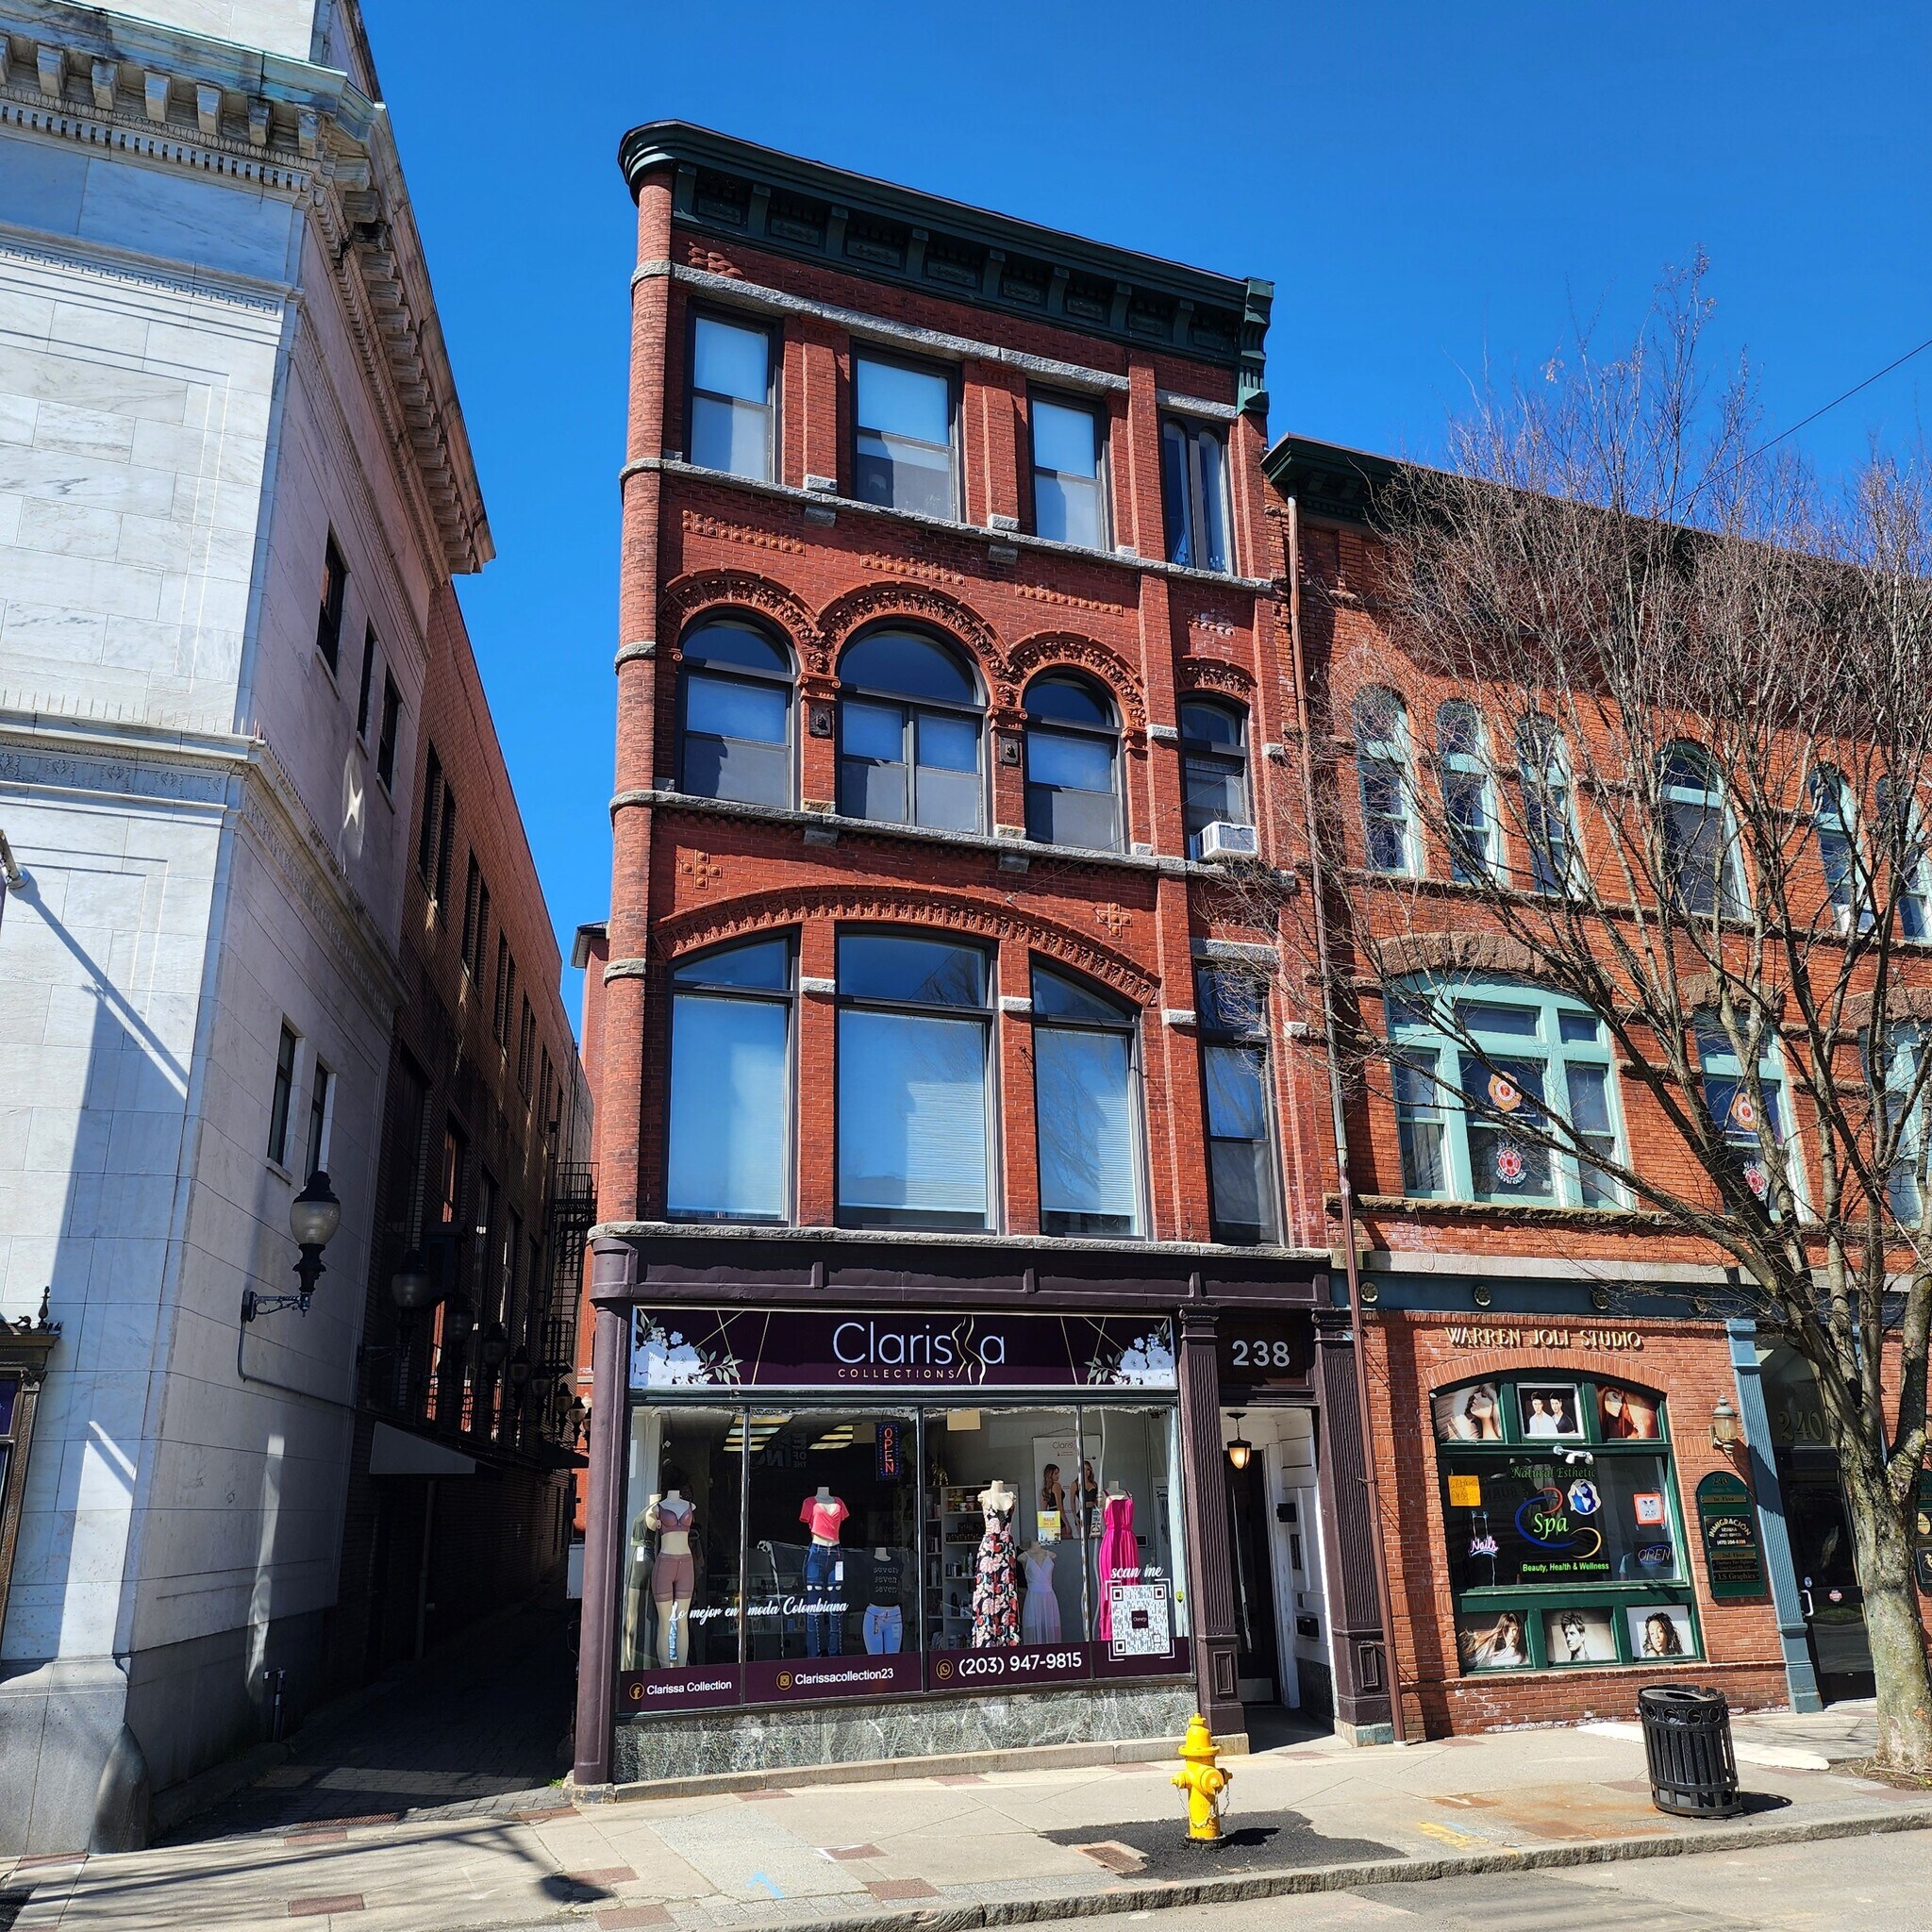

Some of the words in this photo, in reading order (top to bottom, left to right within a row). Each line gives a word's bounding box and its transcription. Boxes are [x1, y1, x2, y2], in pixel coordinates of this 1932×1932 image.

[1444, 1326, 1523, 1346] WARREN
[1529, 1328, 1570, 1346] JOLI
[1579, 1329, 1642, 1348] STUDIO
[1232, 1340, 1291, 1367] 238
[838, 1369, 955, 1379] COLLECTIONS
[1777, 1411, 1824, 1441] 240
[884, 1427, 894, 1473] OPEN
[1510, 1466, 1555, 1480] Natural
[1557, 1466, 1597, 1479] Esthetic
[1533, 1512, 1570, 1540] Spa
[1470, 1536, 1499, 1553] Nails
[1638, 1548, 1671, 1561] OPEN
[1111, 1567, 1141, 1579] scan
[1144, 1564, 1164, 1578] me
[1523, 1563, 1548, 1574] Beauty,
[1549, 1562, 1571, 1572] Health
[1573, 1561, 1578, 1571] &
[1579, 1561, 1609, 1571] Wellness
[669, 1601, 688, 1622] Lo
[690, 1605, 723, 1625] mejor
[724, 1606, 739, 1617] en
[747, 1601, 780, 1616] moda
[782, 1596, 848, 1616] Colombiana
[958, 1656, 1005, 1675] (203)
[1009, 1651, 1083, 1671] 947-9815
[794, 1667, 894, 1685] Clarissacollection23
[646, 1683, 685, 1696] Clarissa
[687, 1679, 732, 1693] Collection
